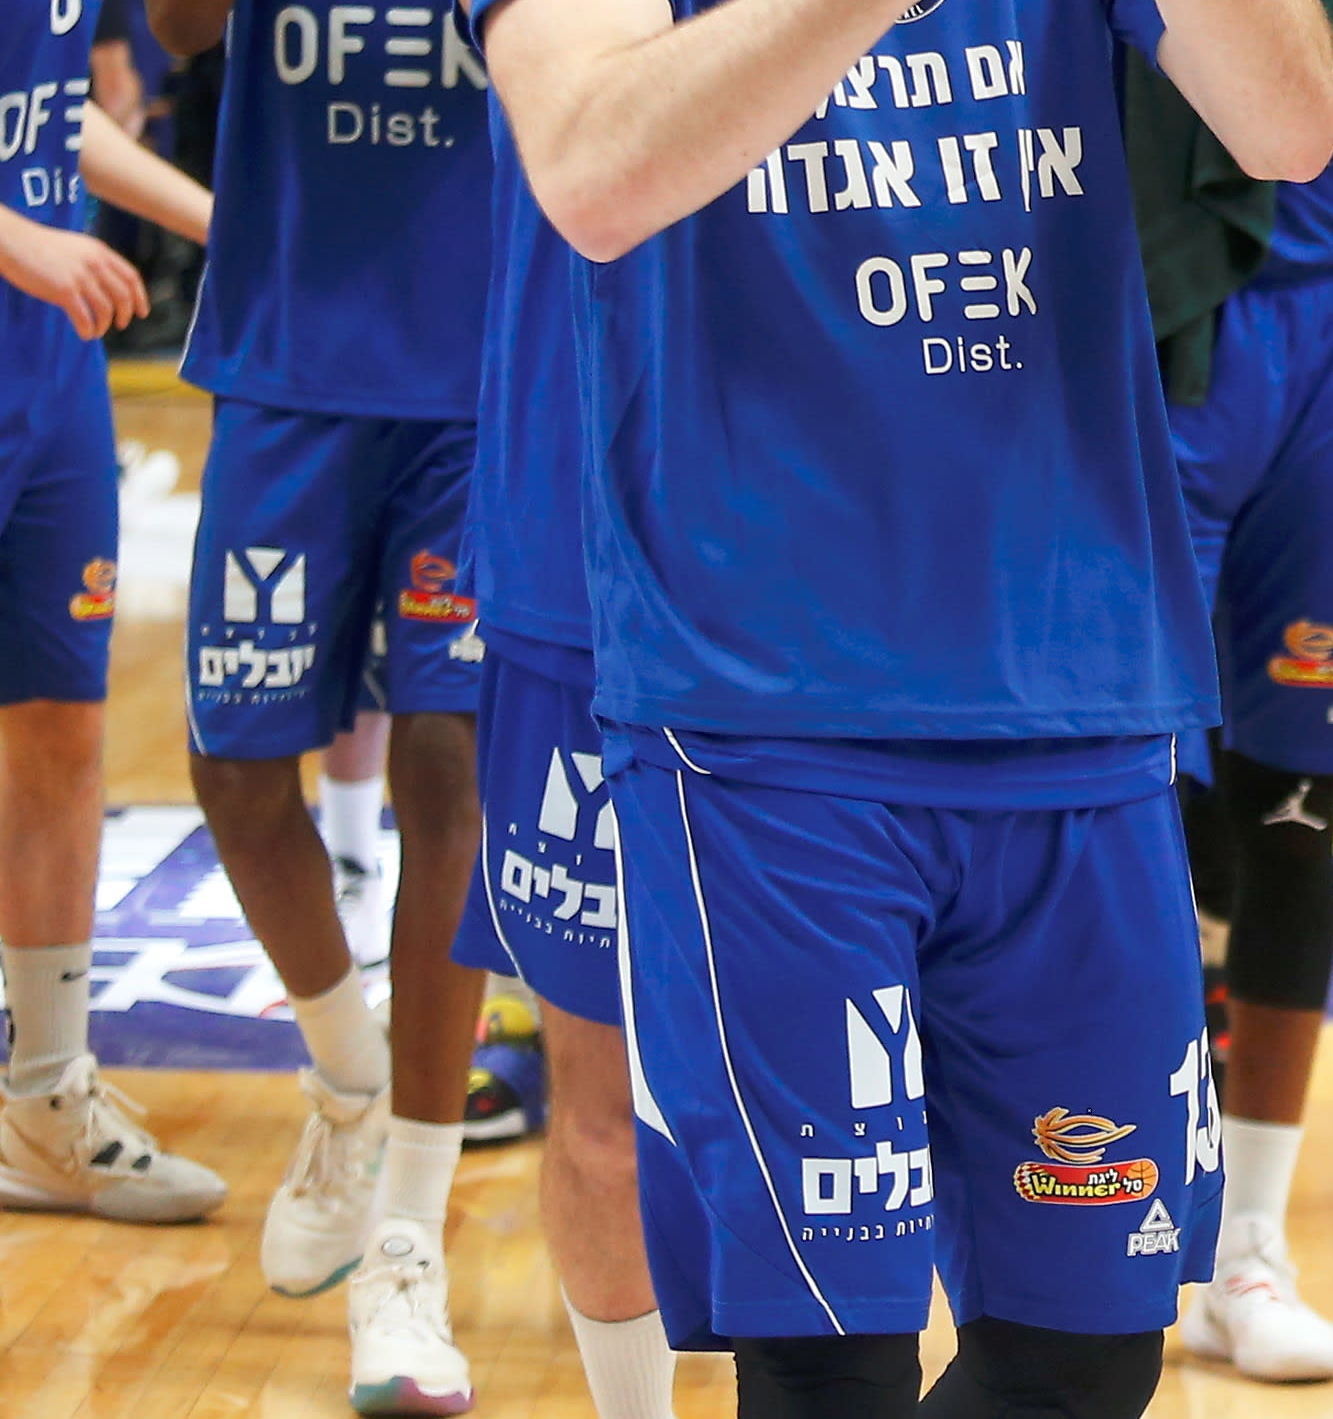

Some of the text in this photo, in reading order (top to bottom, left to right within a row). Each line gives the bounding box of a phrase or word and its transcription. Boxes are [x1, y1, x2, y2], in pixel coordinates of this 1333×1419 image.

[964, 40, 1026, 102] אם
[327, 101, 454, 148] Dist.
[746, 127, 1084, 214] אין זו אגדה
[855, 246, 1038, 327] OFEK
[921, 334, 1024, 375] Dist.
[802, 1141, 934, 1215] בלים
[1031, 1170, 1121, 1198] Winner
[1088, 1166, 1119, 1185] ליגת
[1124, 1177, 1143, 1194] סל
[1127, 1229, 1181, 1257] PEAK
